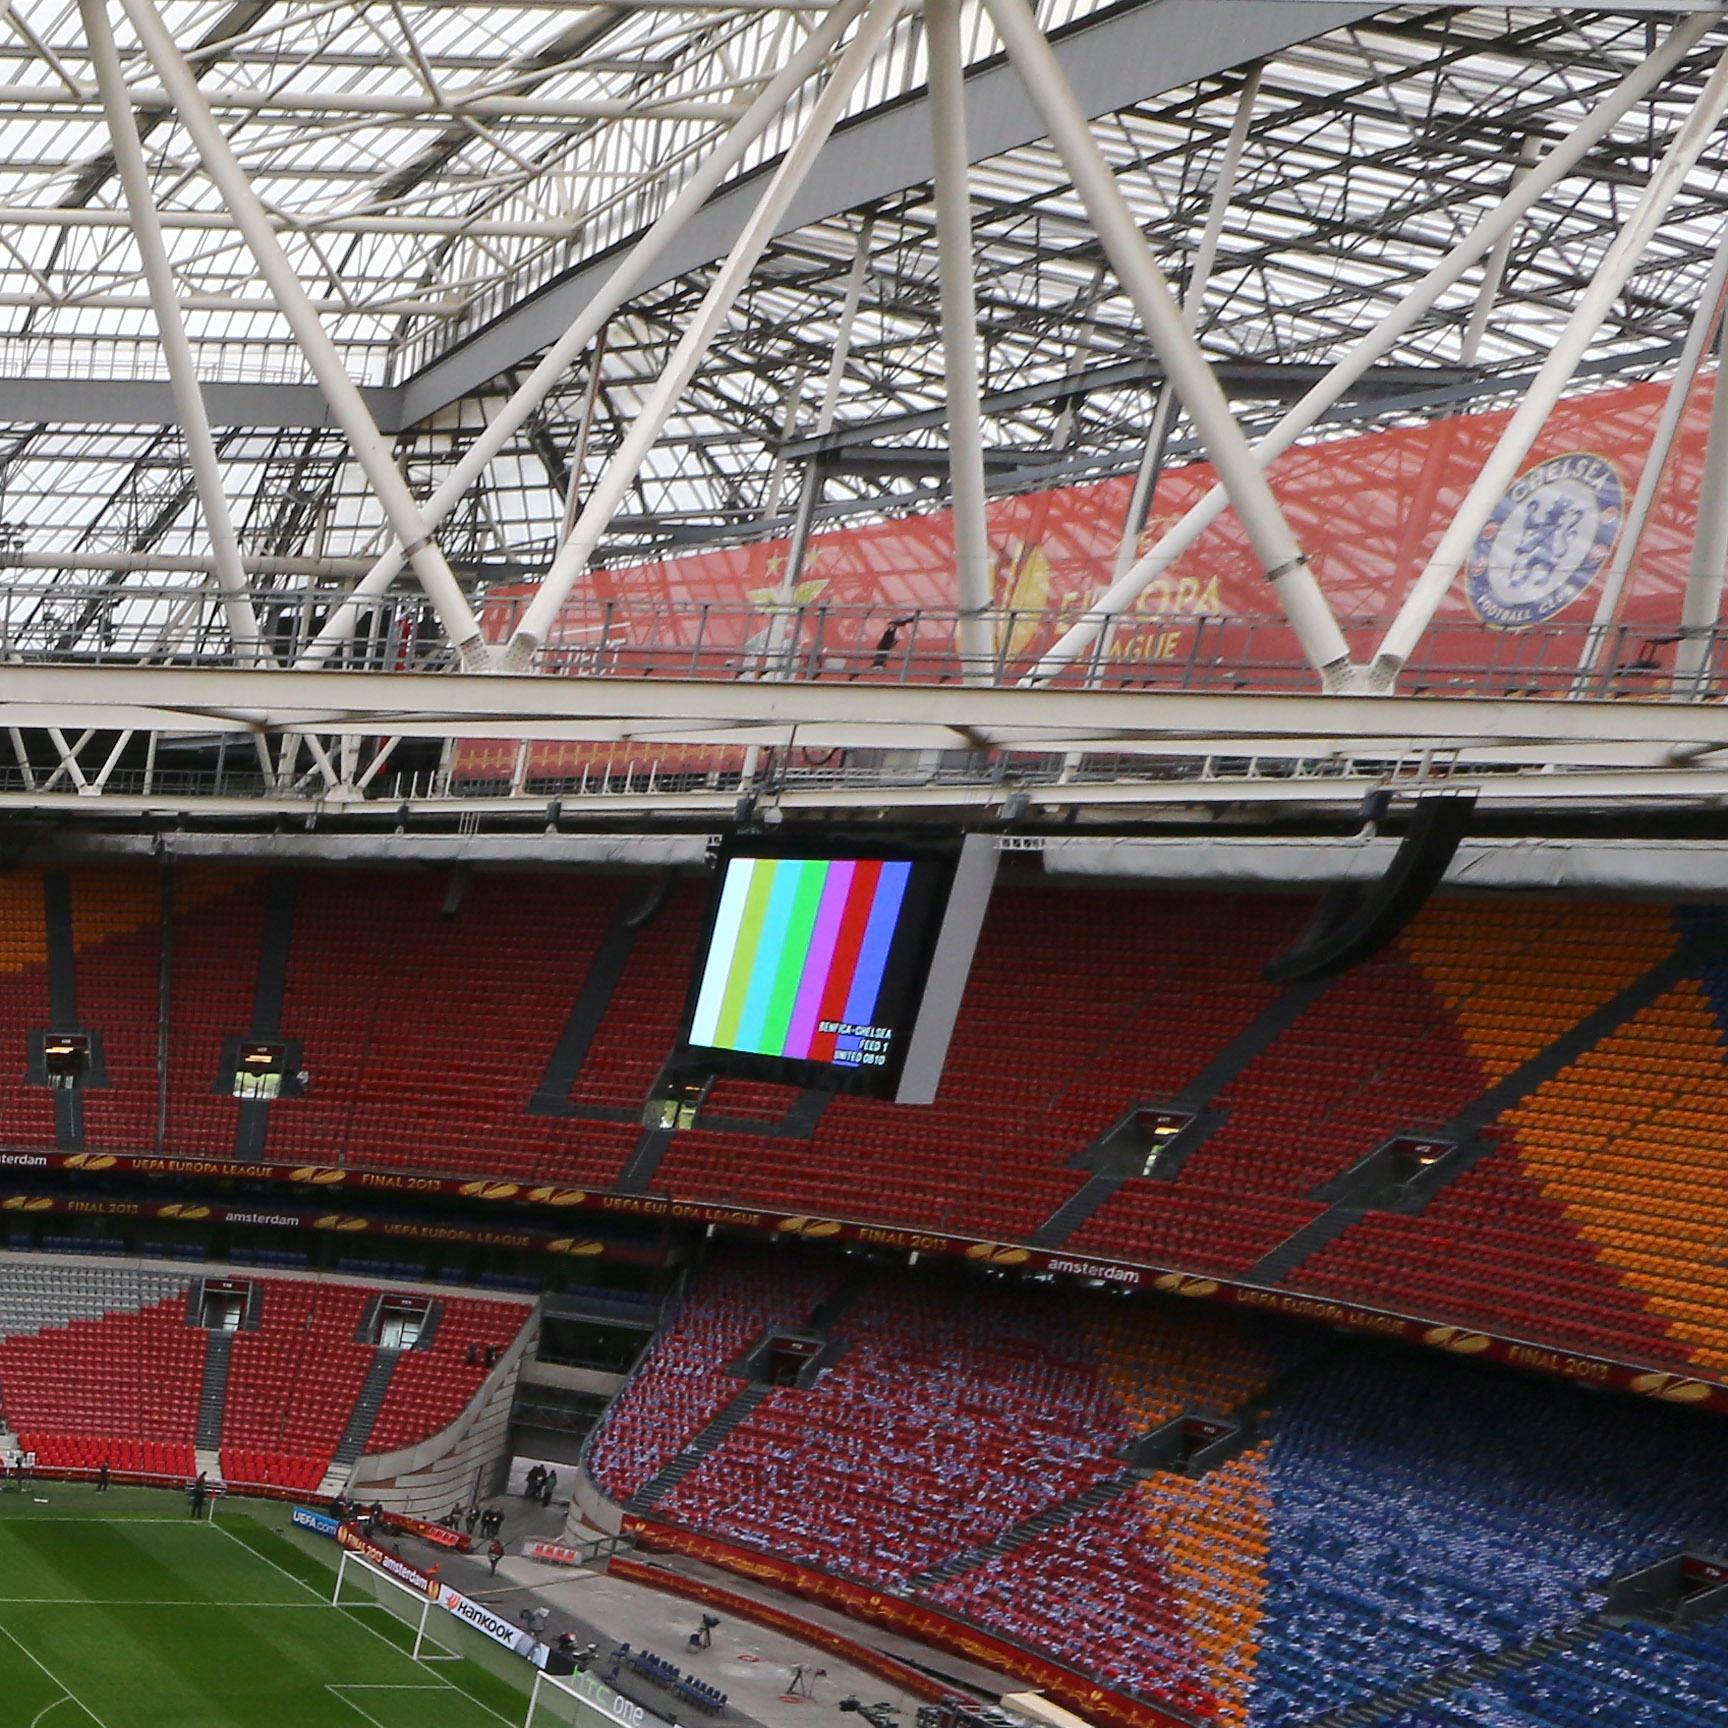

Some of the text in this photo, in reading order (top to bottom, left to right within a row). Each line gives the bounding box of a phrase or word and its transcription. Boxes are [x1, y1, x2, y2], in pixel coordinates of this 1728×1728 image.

[1511, 459, 1609, 503] CHELSEA
[818, 1021, 892, 1039] BENFICA-CHELSEA
[859, 1039, 881, 1051] FEED
[132, 1159, 273, 1178] UEFA EUROPA LEAGUE
[362, 1174, 441, 1192] FINAL 2013
[68, 1201, 138, 1215] FINAL 2013
[226, 1211, 299, 1227] amsterdam
[603, 1197, 640, 1212] UEFA
[705, 1208, 760, 1227] LEAGUE
[384, 1223, 529, 1247] UEFA EUROPA LEAGUE
[859, 1228, 947, 1251] FINAL 2013
[1048, 1258, 1140, 1284] amsterdam
[1509, 1345, 1610, 1381] FINAL 2013
[293, 1512, 337, 1537] UEFA.com
[382, 1555, 428, 1590] amsterdam
